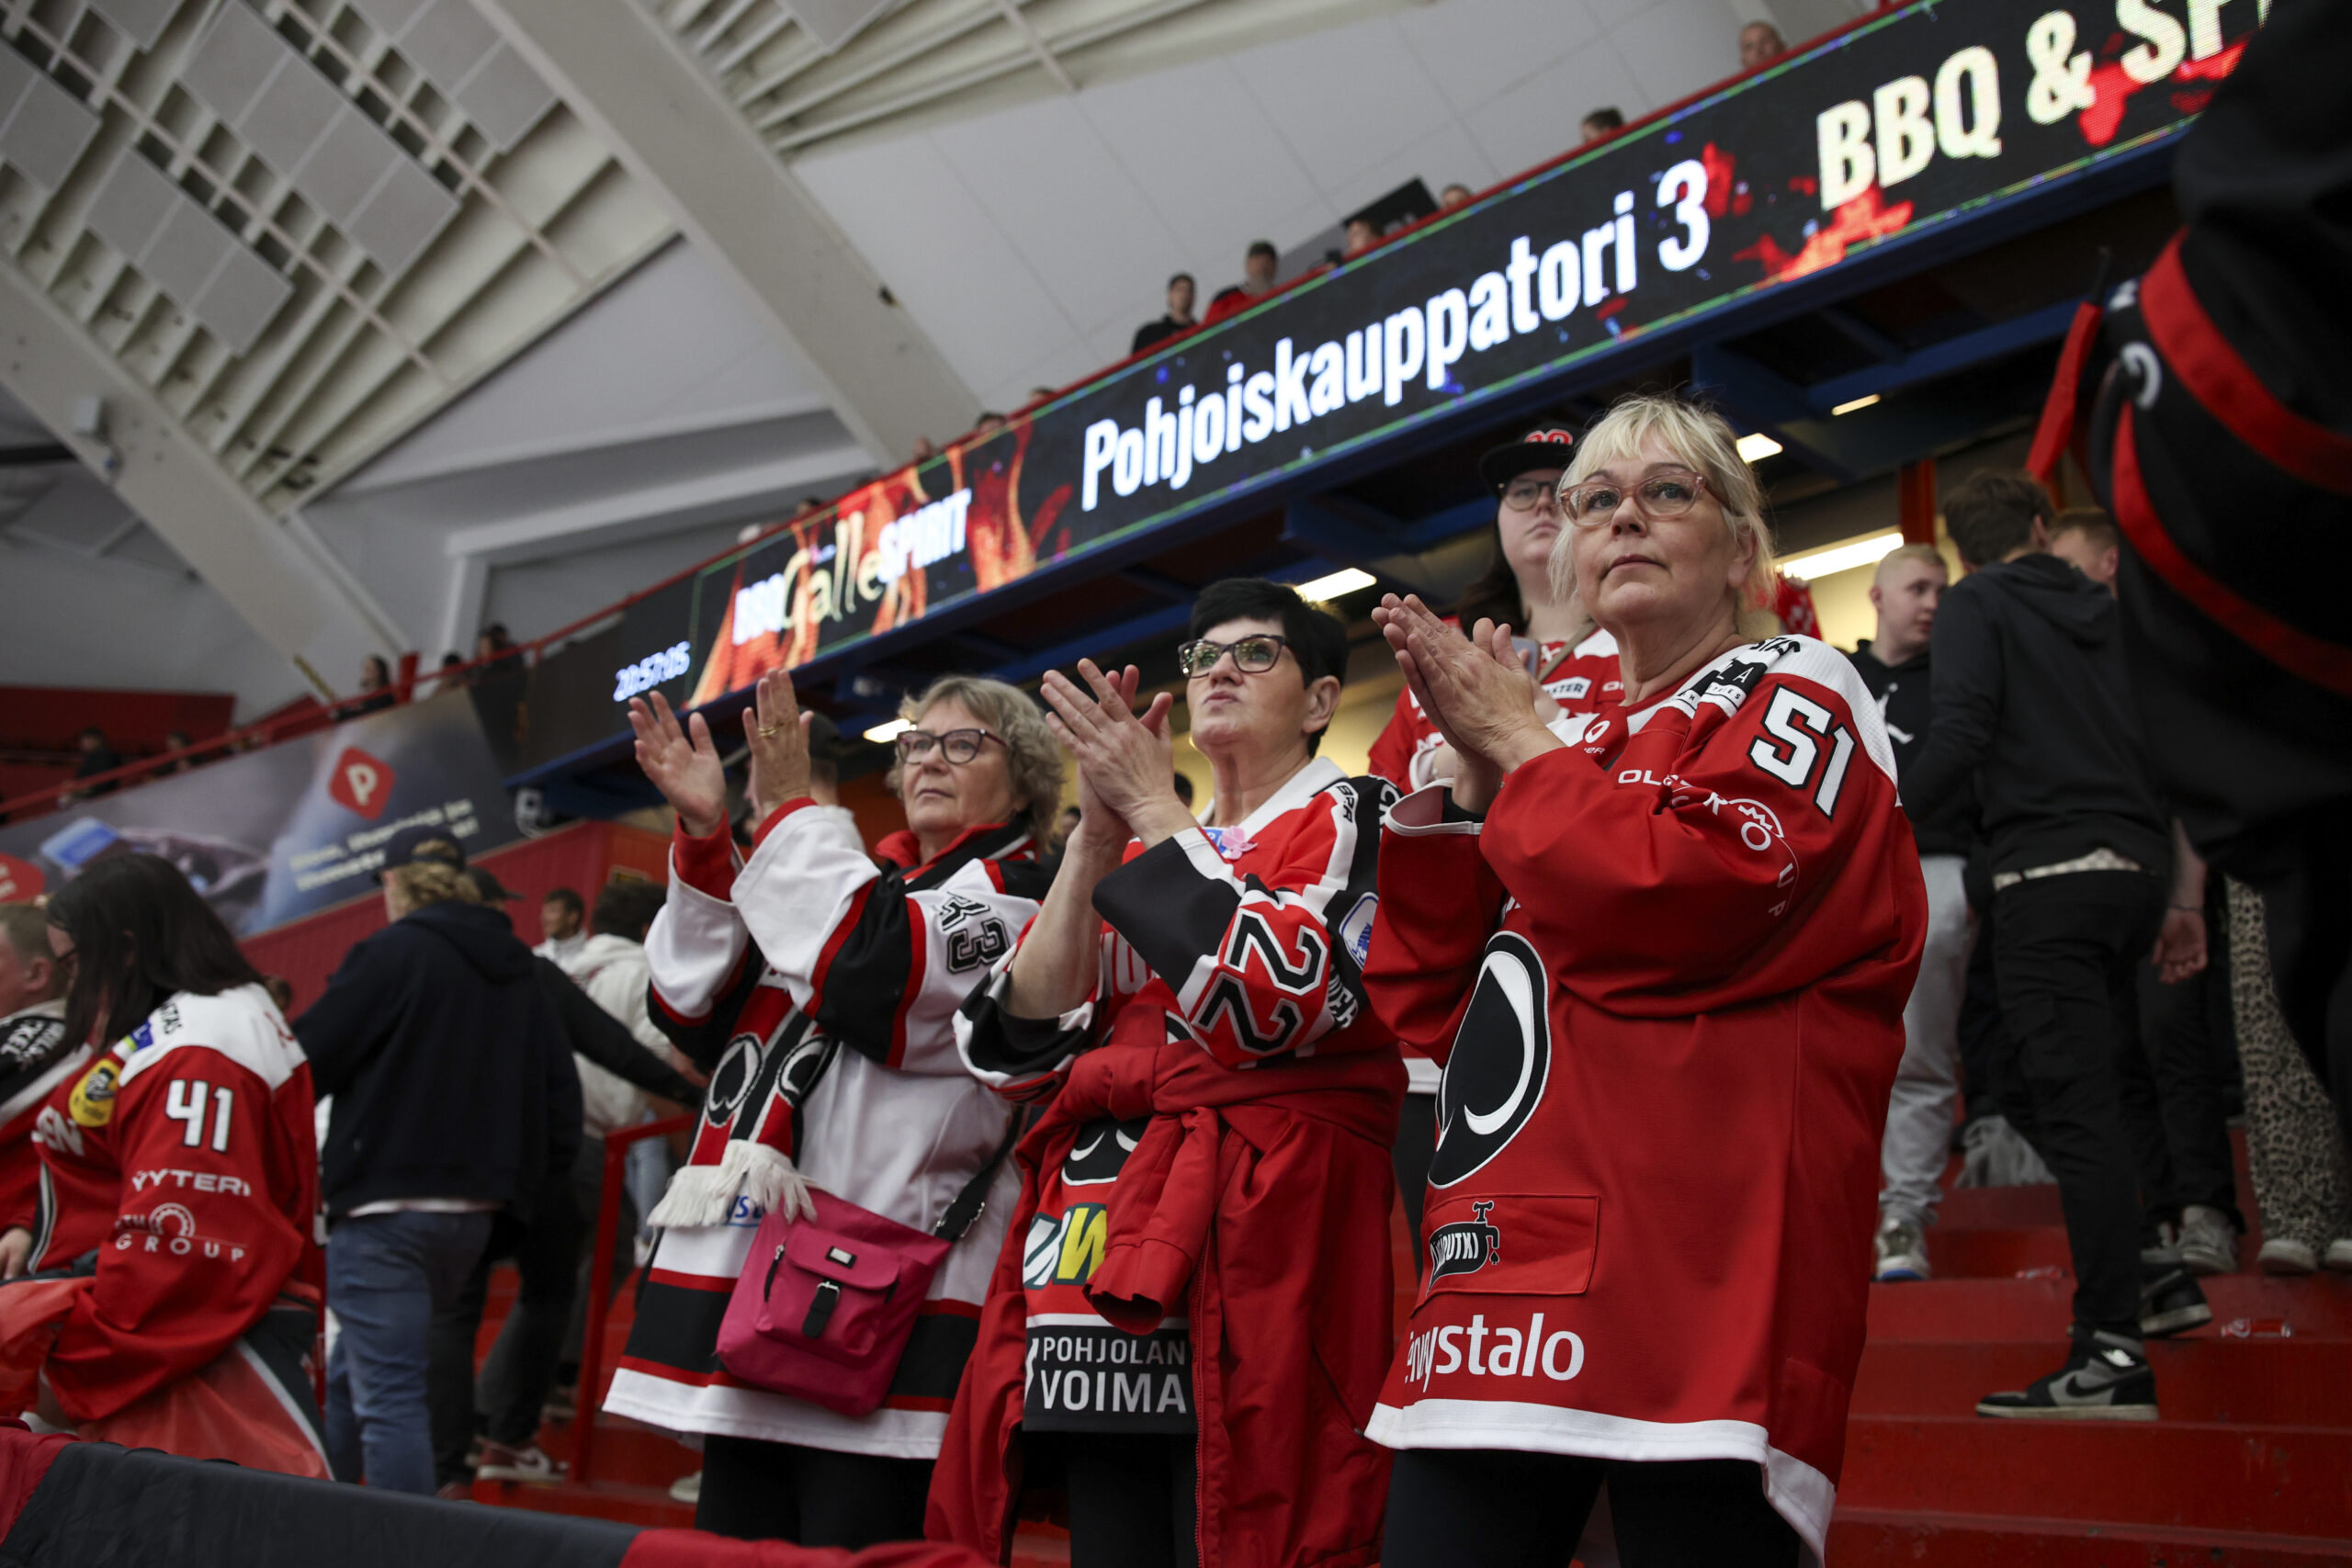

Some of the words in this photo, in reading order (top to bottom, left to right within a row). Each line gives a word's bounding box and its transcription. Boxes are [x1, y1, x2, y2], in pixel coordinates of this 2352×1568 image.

[1816, 45, 2002, 212] BBQ
[2026, 10, 2096, 125] &
[1082, 190, 1635, 512] Pohjoiskauppatori
[1657, 159, 1711, 272] 3
[877, 488, 972, 583] SPIRIT
[1747, 682, 1858, 824] 51
[1191, 907, 1329, 1055] 22
[165, 1078, 233, 1154] 41
[132, 1168, 251, 1197] YYTERI
[116, 1234, 245, 1262] GROUP
[1041, 1370, 1187, 1414] VOIMA
[1043, 1337, 1185, 1365] POHJOLAN
